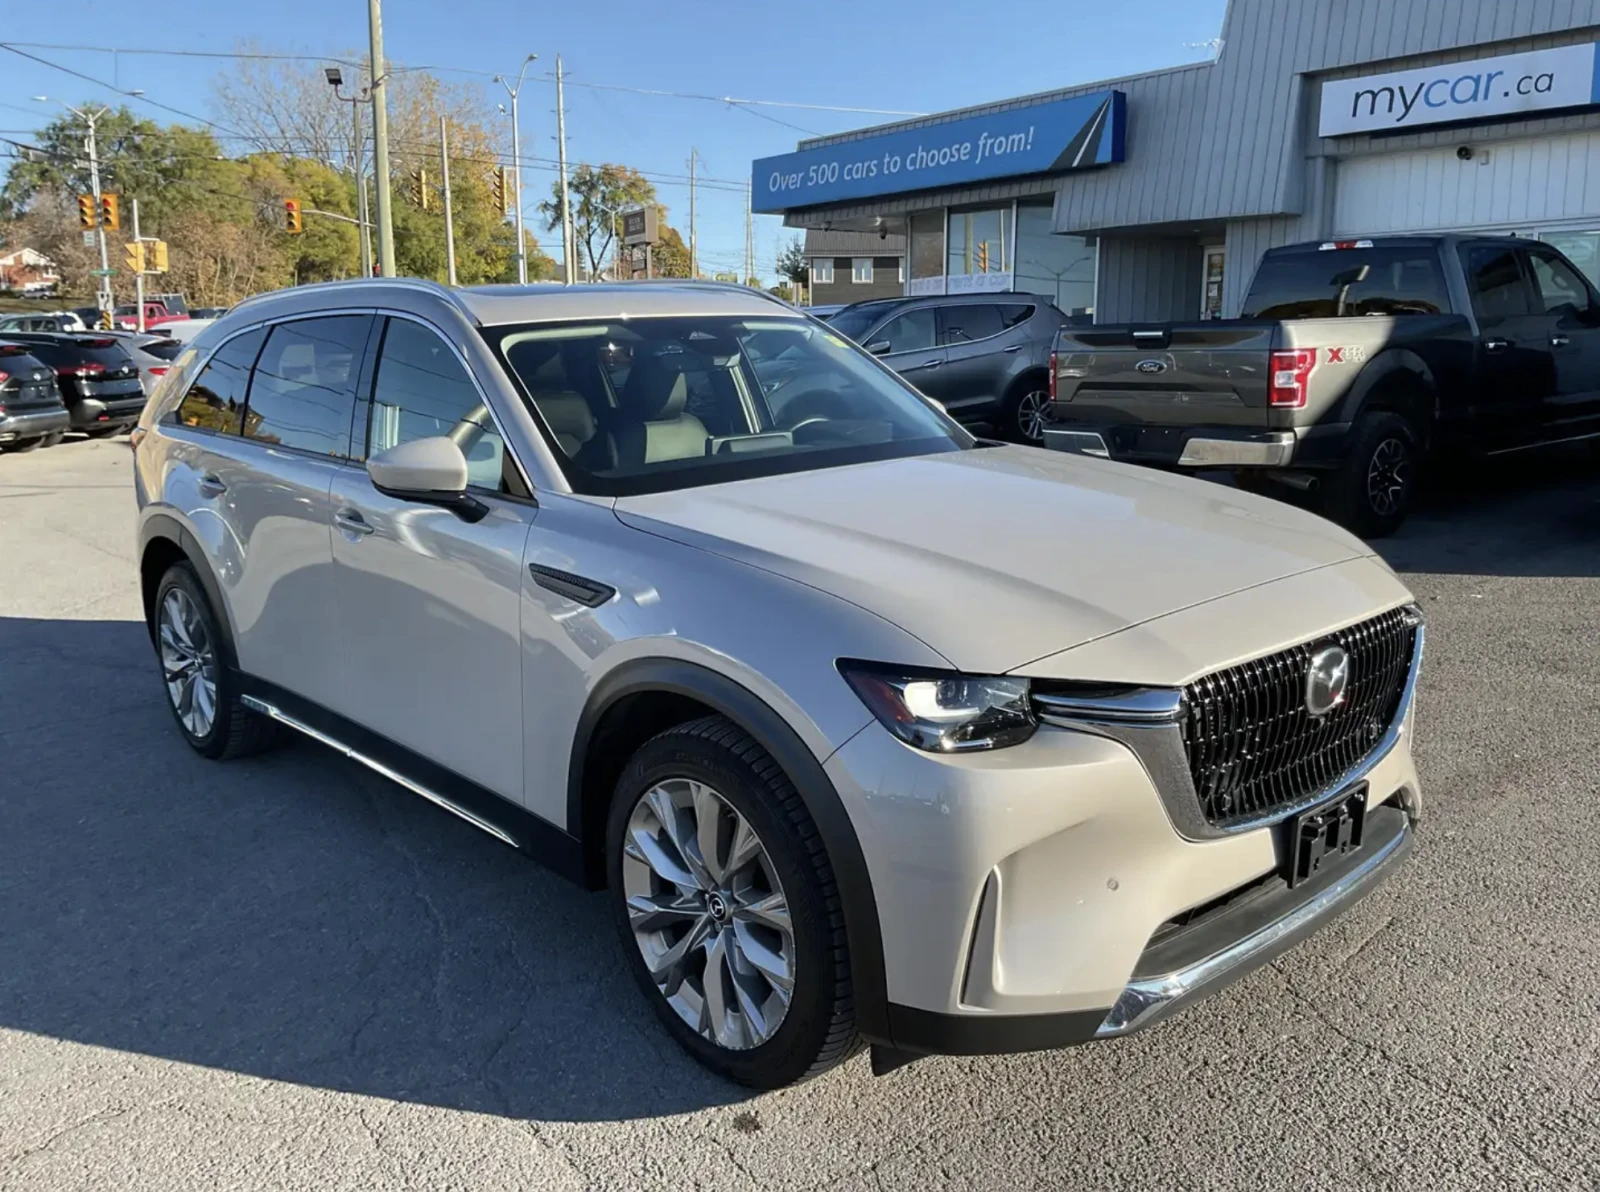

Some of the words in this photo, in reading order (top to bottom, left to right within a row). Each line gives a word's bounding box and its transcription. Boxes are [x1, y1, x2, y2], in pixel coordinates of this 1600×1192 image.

[1351, 70, 1554, 122] mycar.ca
[769, 171, 804, 192] Over
[807, 162, 839, 186] 500
[843, 159, 877, 180] cars
[883, 152, 900, 174] to
[906, 142, 971, 171] choose
[975, 126, 1035, 165] from!
